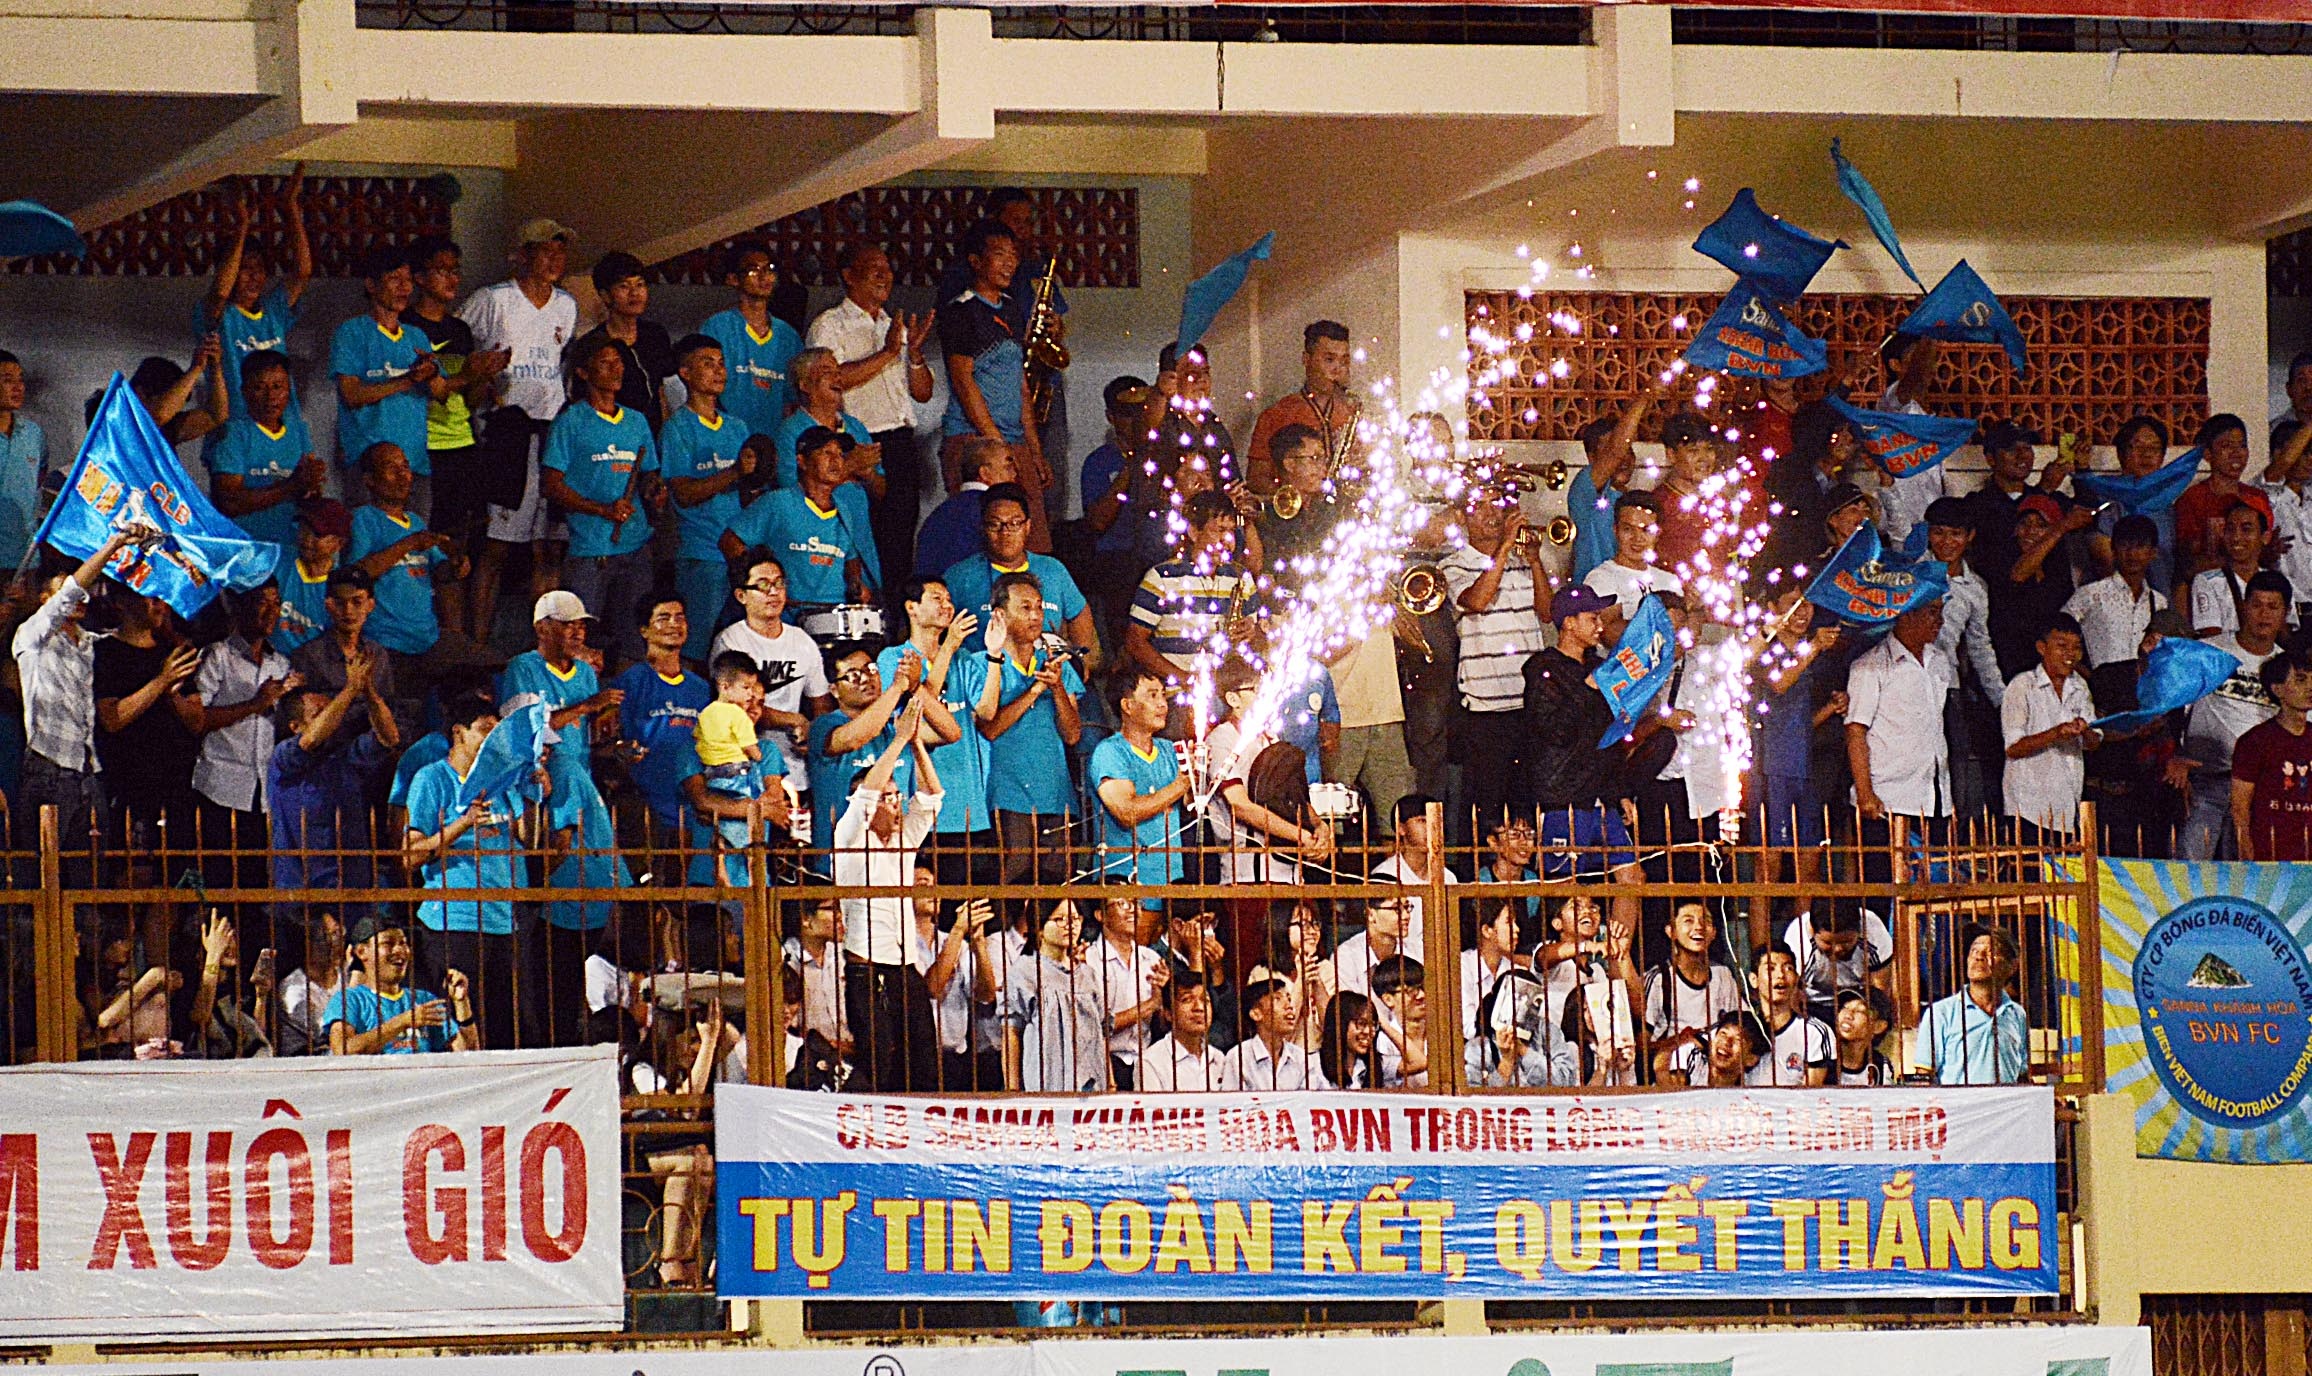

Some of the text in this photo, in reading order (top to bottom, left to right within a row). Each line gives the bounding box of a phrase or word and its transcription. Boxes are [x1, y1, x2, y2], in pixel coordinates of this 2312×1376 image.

[1728, 352, 1781, 376] BVN
[1884, 442, 1940, 473] BVN
[150, 481, 192, 526] CLB
[761, 660, 797, 679] NIKE
[2141, 964, 2156, 1001] CTY
[2149, 942, 2165, 967] CP
[2188, 1020, 2281, 1044] BVN FC
[2152, 1025, 2174, 1061] BIEN
[2168, 1055, 2193, 1089] VIET
[2187, 1082, 2219, 1112] NAM
[2217, 1092, 2284, 1119] FOOTBALL
[837, 1103, 909, 1150] CLB
[923, 1105, 1060, 1151] SANNA
[1072, 1101, 1208, 1152] KHÁNH
[1218, 1098, 1300, 1152] HÒA
[1310, 1108, 1391, 1153] BVN
[1404, 1107, 1532, 1152] TRONG
[1546, 1098, 1645, 1152] LÒNG
[87, 1099, 353, 1271] XUÔI
[402, 1088, 588, 1265] GIÓ
[740, 1170, 2041, 1289] TỰ TIN ĐOÀN KẾT, QUYẾT THẮNG
